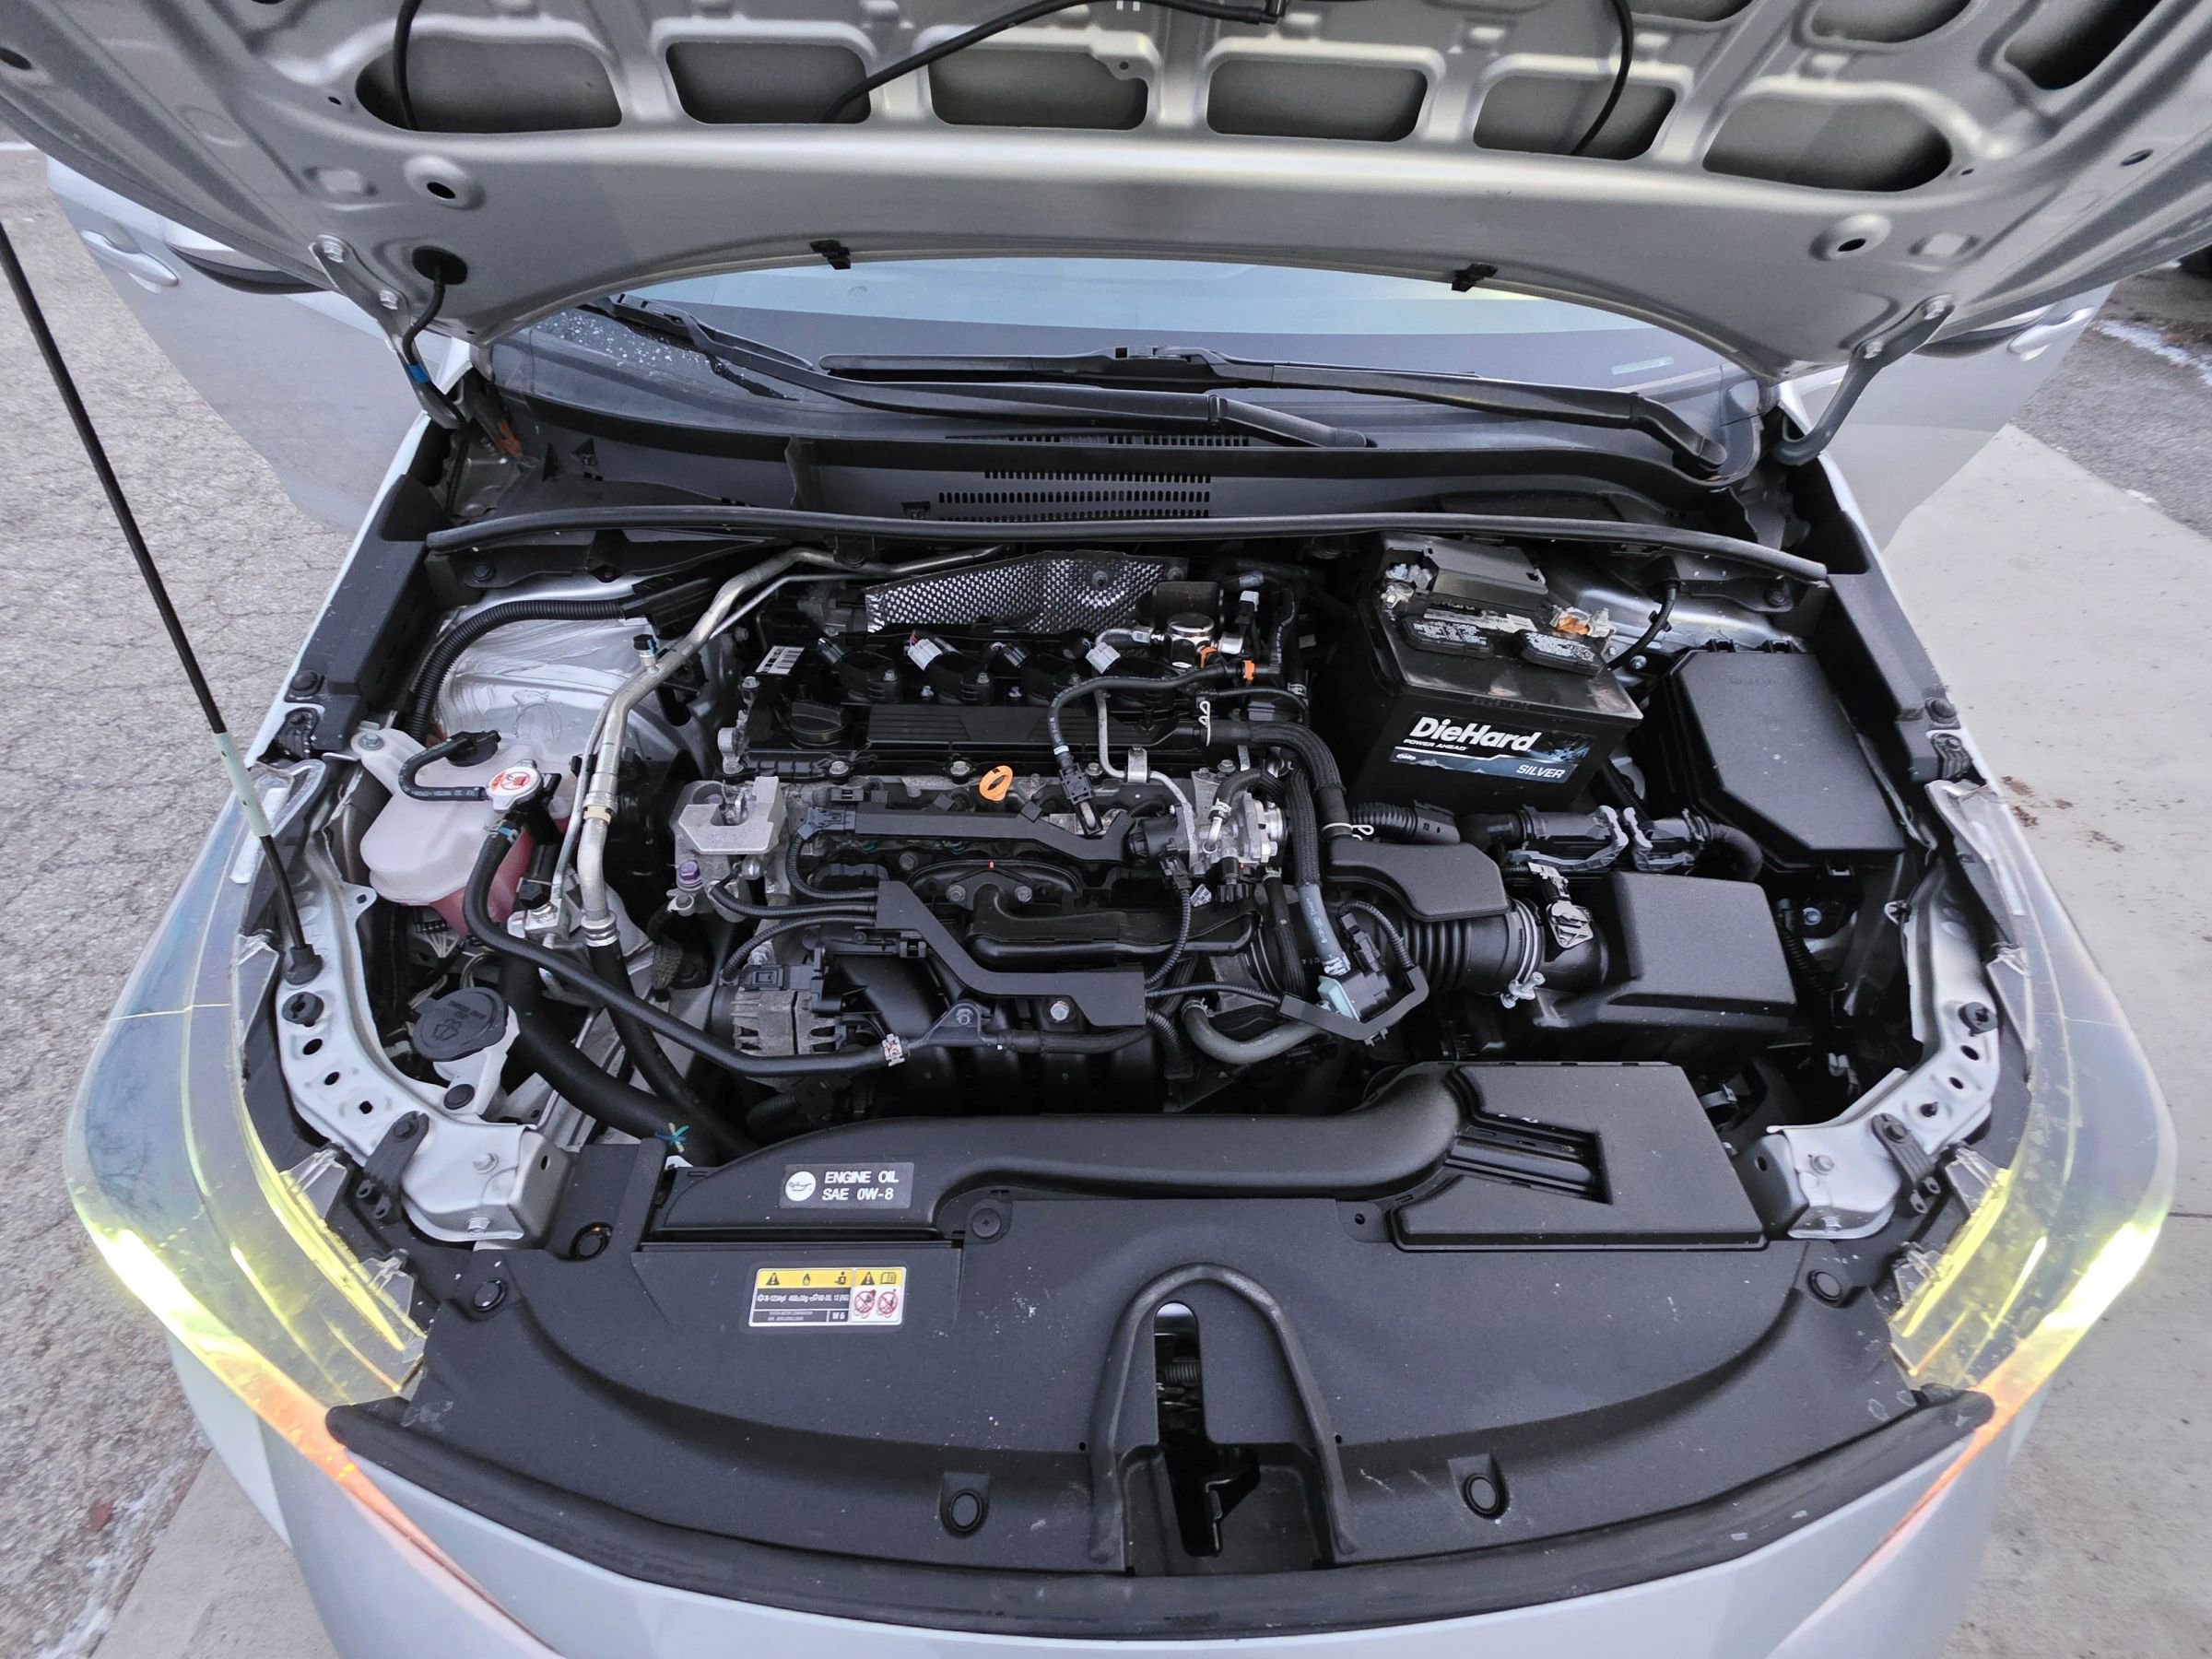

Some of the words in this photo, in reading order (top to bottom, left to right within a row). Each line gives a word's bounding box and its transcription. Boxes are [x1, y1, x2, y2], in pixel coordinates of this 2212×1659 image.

[1409, 716, 1542, 752] DieHard
[1403, 738, 1435, 747] POWER
[1435, 743, 1467, 751] AHEAD
[1516, 764, 1566, 779] SILVER
[824, 1171, 872, 1183] ENGINE
[877, 1170, 900, 1183] OIL
[822, 1188, 849, 1201] SAE
[856, 1188, 894, 1201] 0W-8
